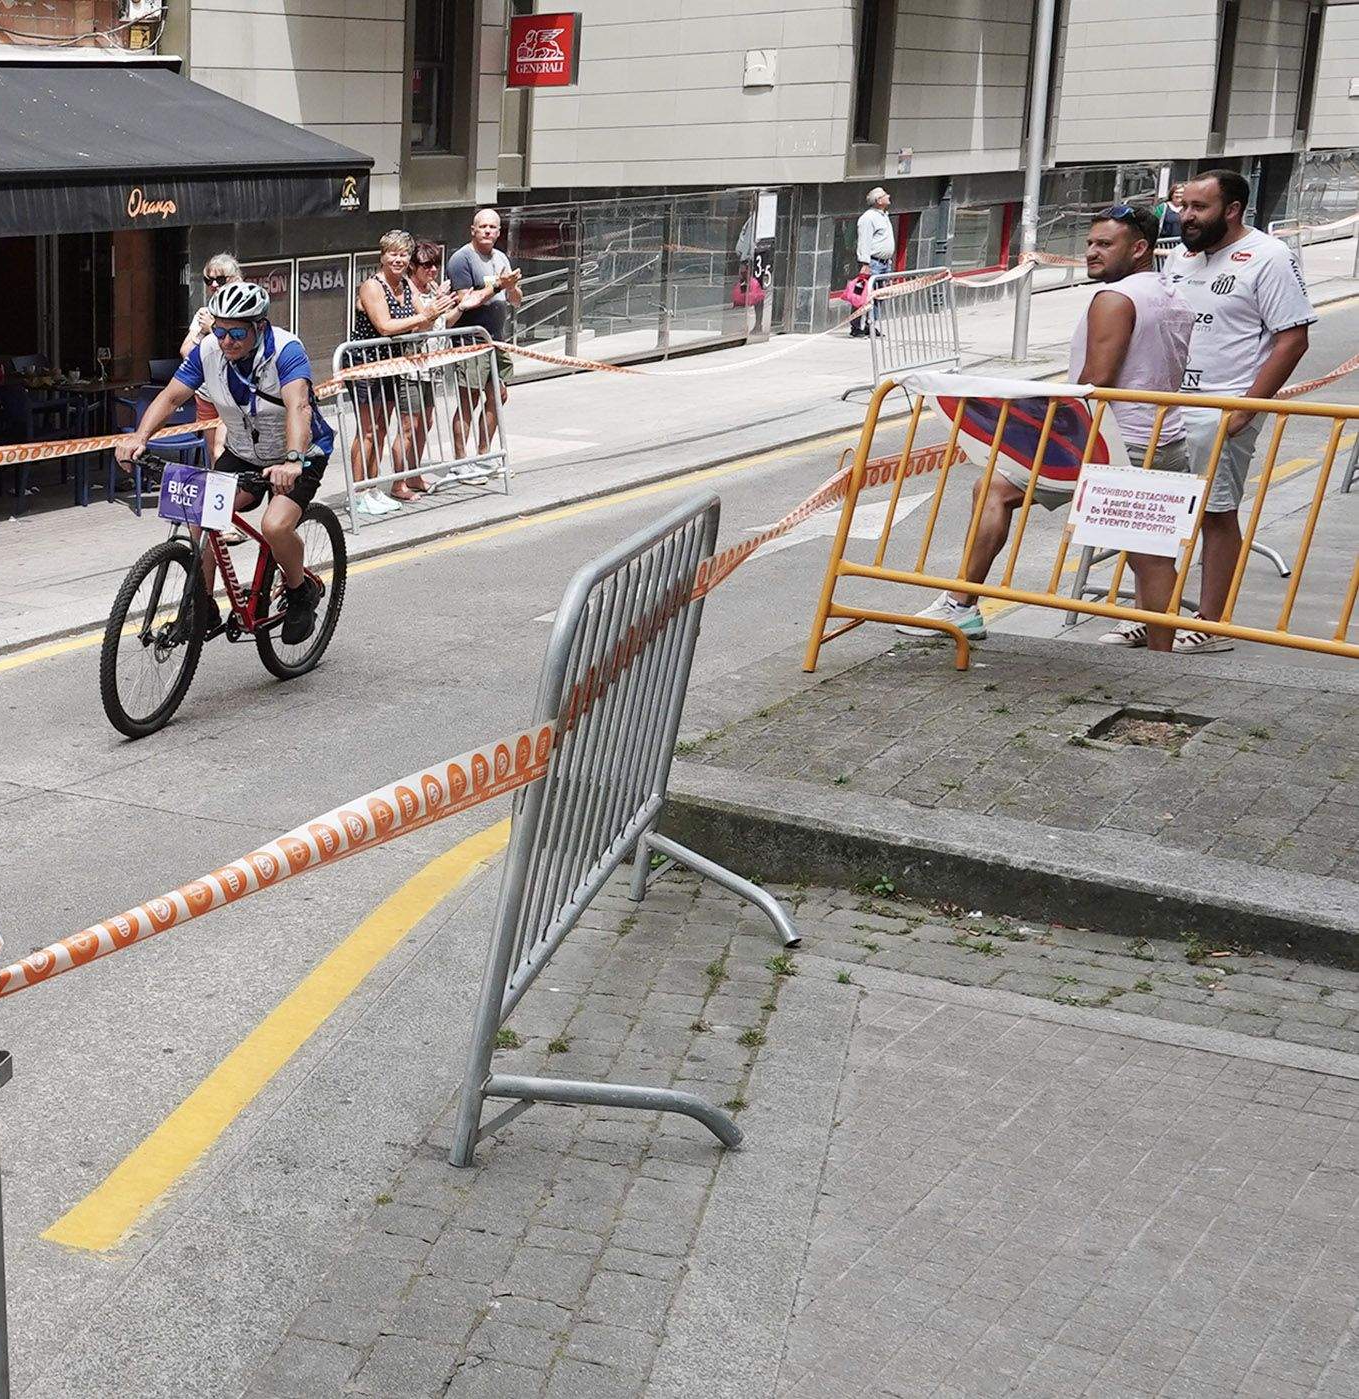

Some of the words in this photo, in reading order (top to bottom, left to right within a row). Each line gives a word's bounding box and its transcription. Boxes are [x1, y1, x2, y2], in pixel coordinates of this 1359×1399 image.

[516, 61, 564, 74] GENERALI
[300, 270, 345, 292] SABA
[167, 480, 199, 498] BIKE
[1092, 486, 1134, 498] PROHIBIDO
[1135, 491, 1185, 504] ESTACIONAR
[171, 494, 193, 507] FULL
[213, 493, 225, 511] 3
[1110, 499, 1131, 509] partir
[1132, 501, 1146, 510] das
[1148, 502, 1158, 511] 23
[1102, 507, 1133, 519] VENRES
[1085, 515, 1098, 524] Por
[1099, 517, 1130, 528] EVENTO
[1131, 521, 1176, 534] DEPORTIVO
